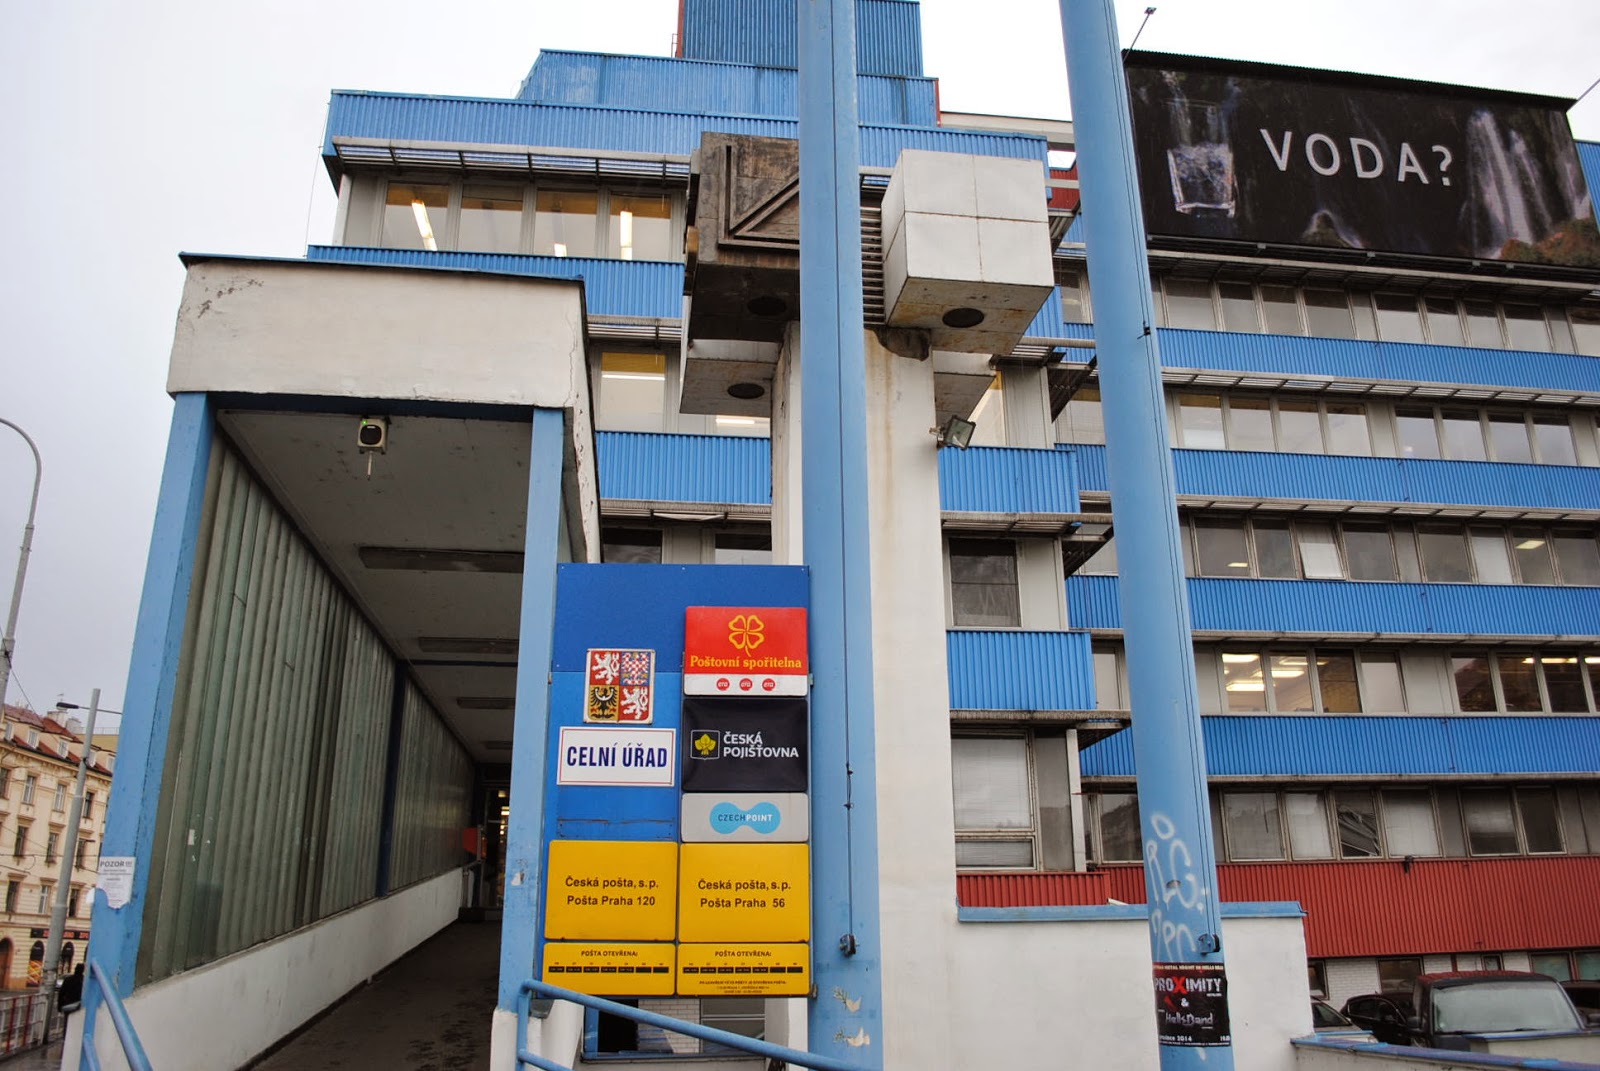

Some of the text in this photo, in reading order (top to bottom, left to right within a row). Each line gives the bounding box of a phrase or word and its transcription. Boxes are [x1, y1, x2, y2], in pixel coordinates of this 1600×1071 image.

[1260, 128, 1452, 186] VODA?
[690, 655, 802, 670] Poštovní spořitelna
[723, 731, 763, 745] ČESKÁ
[567, 742, 668, 768] CELNÍ ÚŘAD
[723, 744, 799, 759] POJIŠŤOVNA
[565, 875, 599, 887] Česká
[602, 877, 637, 889] pošta,
[698, 878, 732, 890] Česká
[735, 880, 769, 892] pošta,
[567, 895, 656, 906] Pošta Praha 120
[700, 897, 785, 908] Pošta Praha 56
[1154, 976, 1221, 995] PROXIMITY
[1181, 997, 1190, 1007] &
